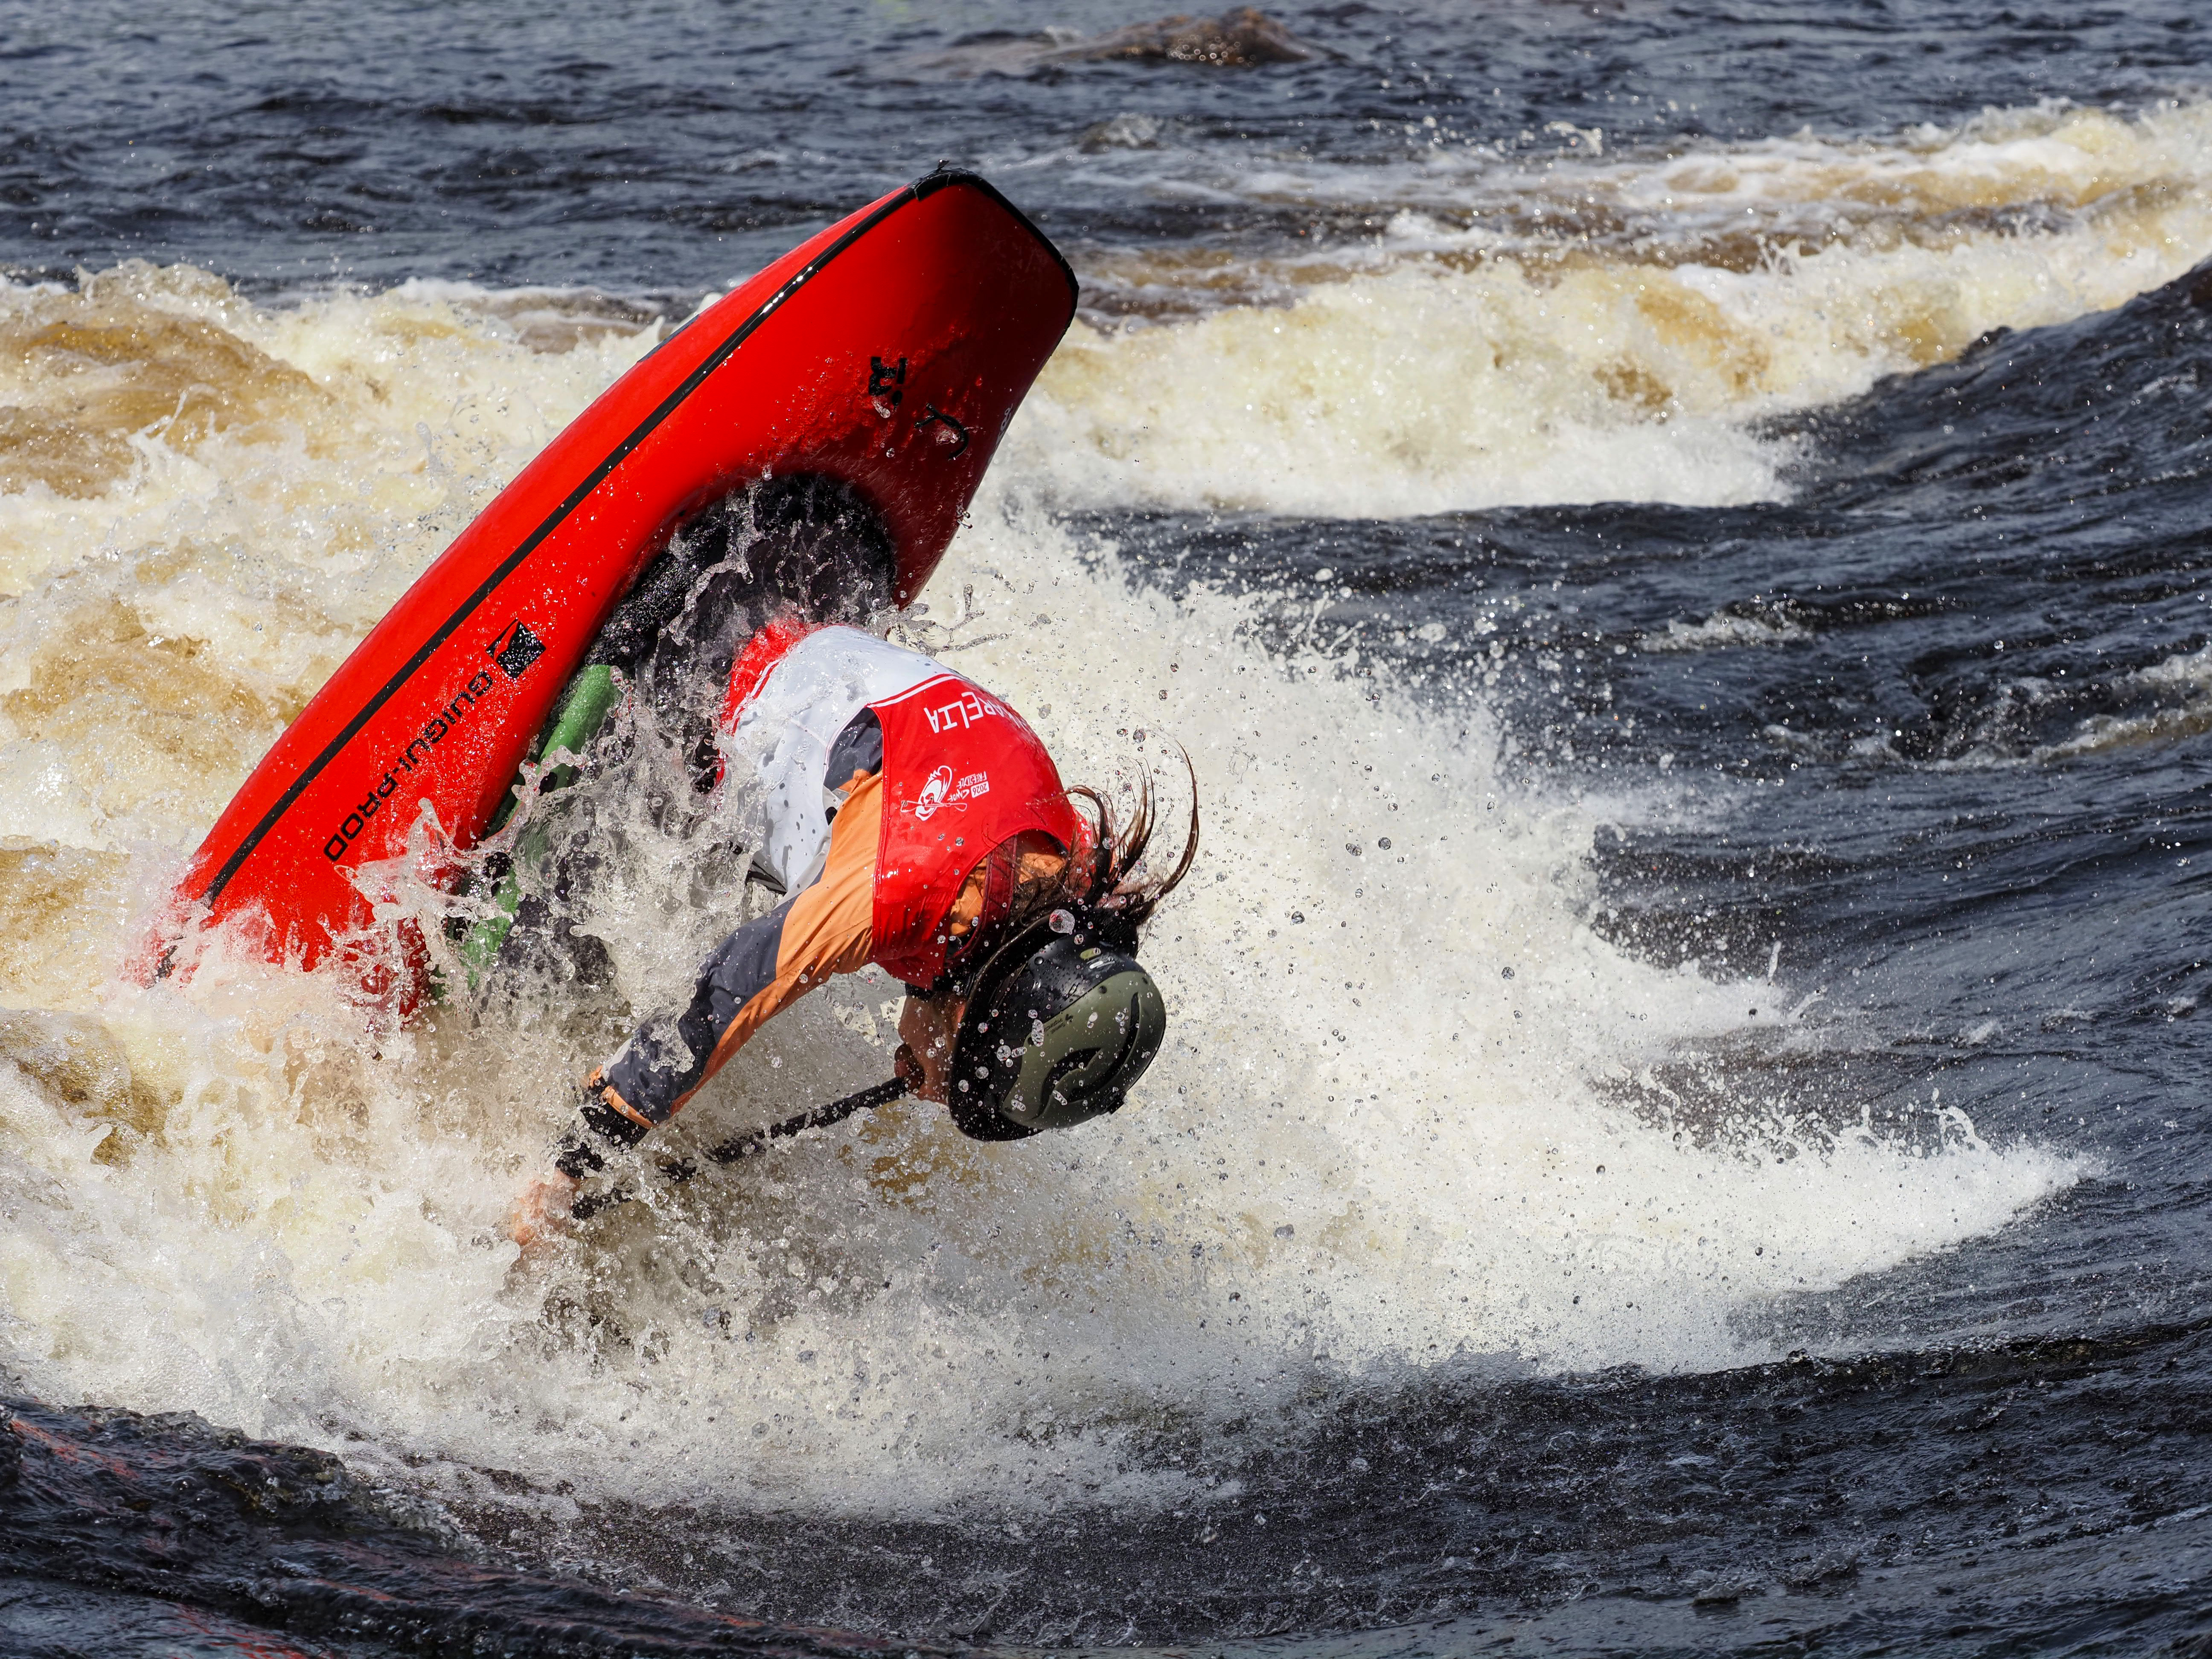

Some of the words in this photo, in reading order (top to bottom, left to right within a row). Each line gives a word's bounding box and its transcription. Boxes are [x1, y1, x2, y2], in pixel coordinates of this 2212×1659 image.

[323, 671, 493, 862] GUIGUI-PROD
[956, 771, 987, 788] FREESTYLE
[947, 789, 970, 802] CANOE
[972, 784, 987, 797] 2026
